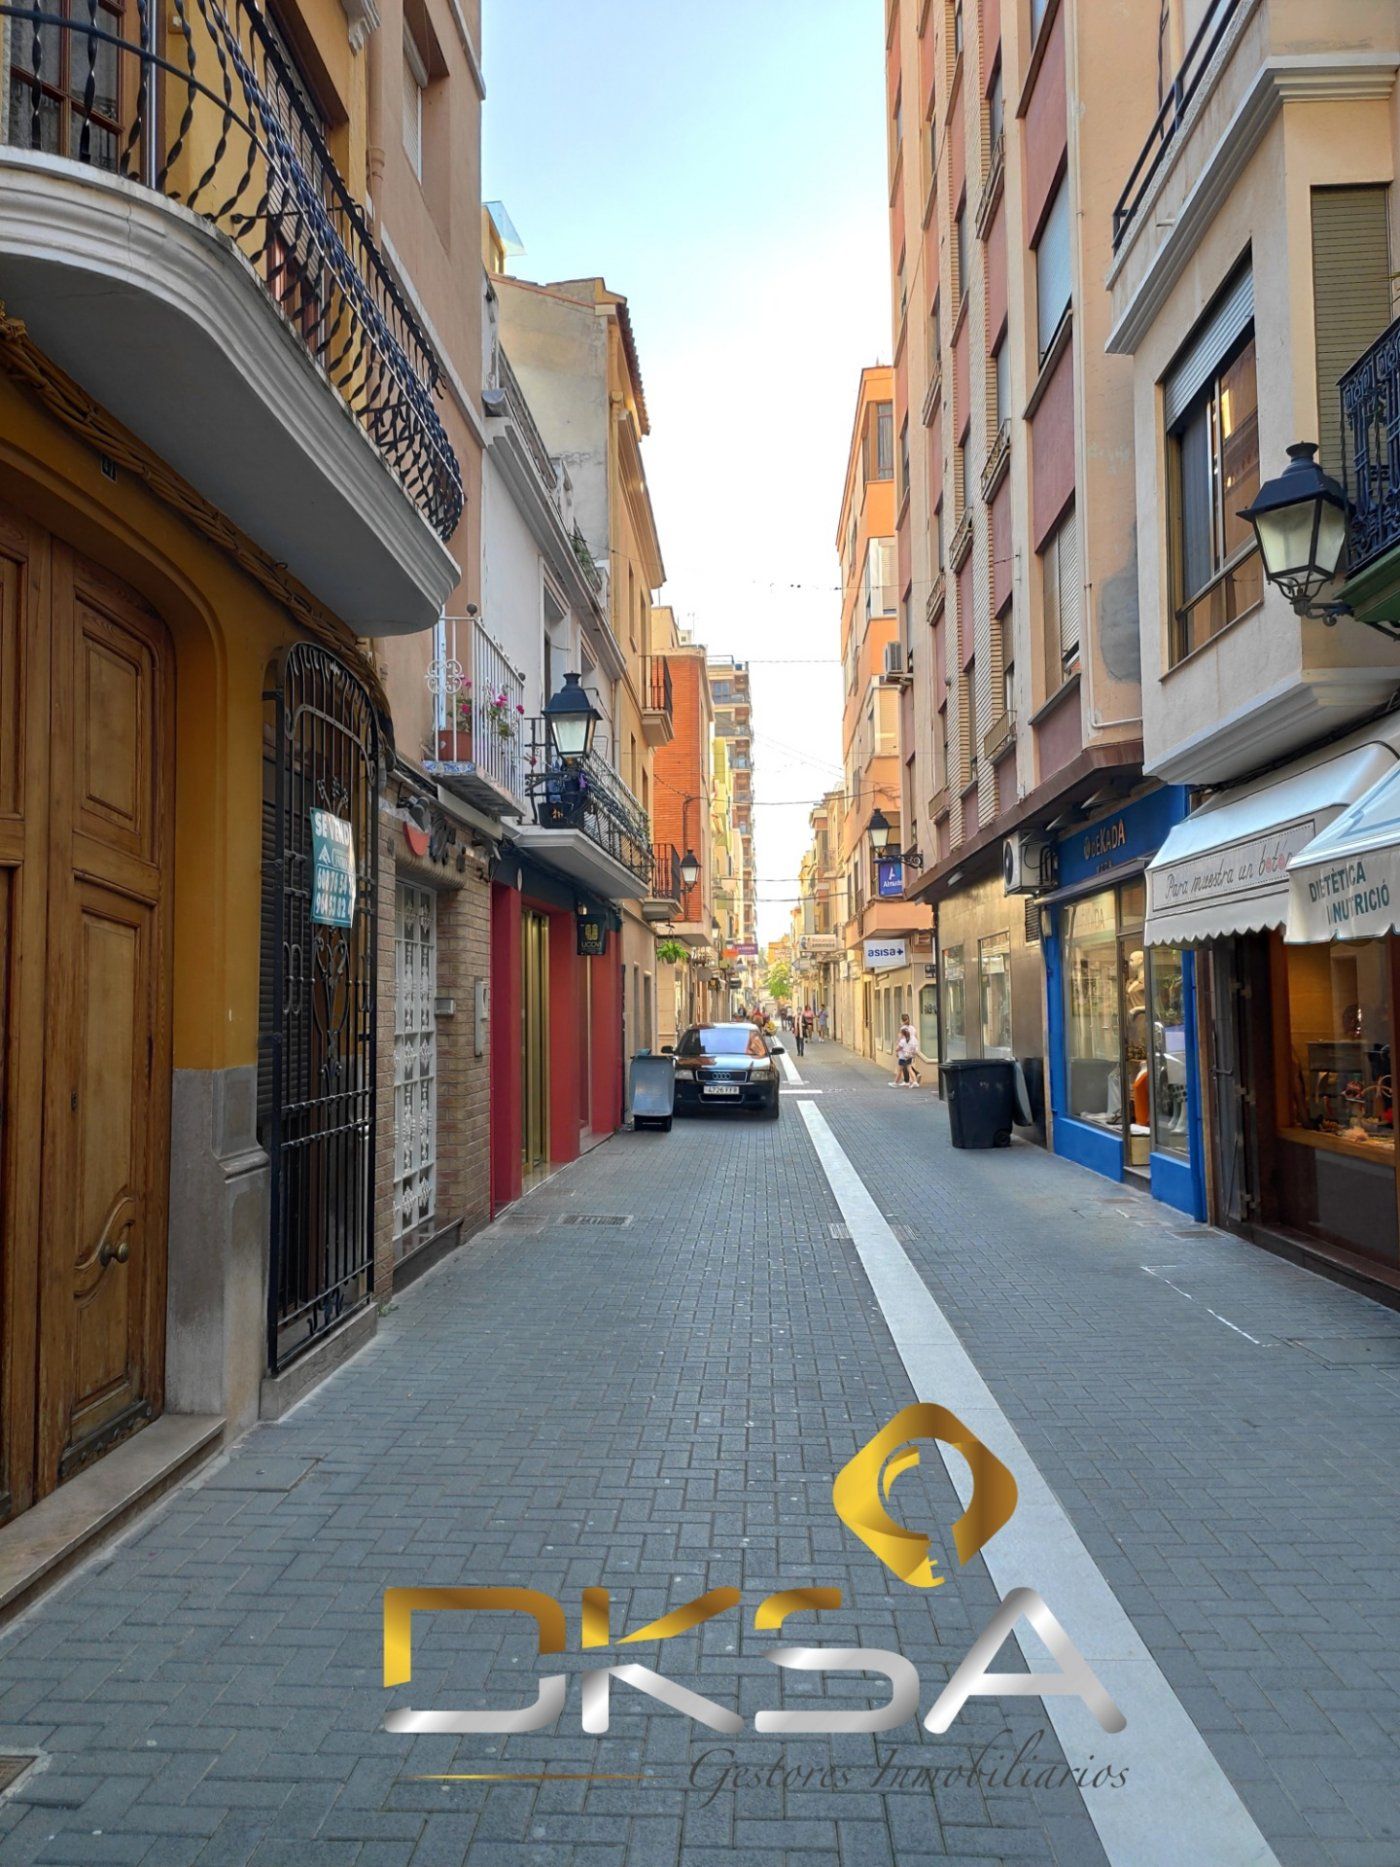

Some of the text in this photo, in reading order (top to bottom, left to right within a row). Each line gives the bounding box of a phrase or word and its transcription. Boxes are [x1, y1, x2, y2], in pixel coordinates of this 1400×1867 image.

[1165, 873, 1188, 899] Para
[1191, 858, 1234, 893] muestra
[1238, 863, 1253, 880] un
[1308, 861, 1366, 903] DIETÈTICA
[1332, 878, 1390, 924] NUTRICIÓ
[867, 948, 896, 957] asisa
